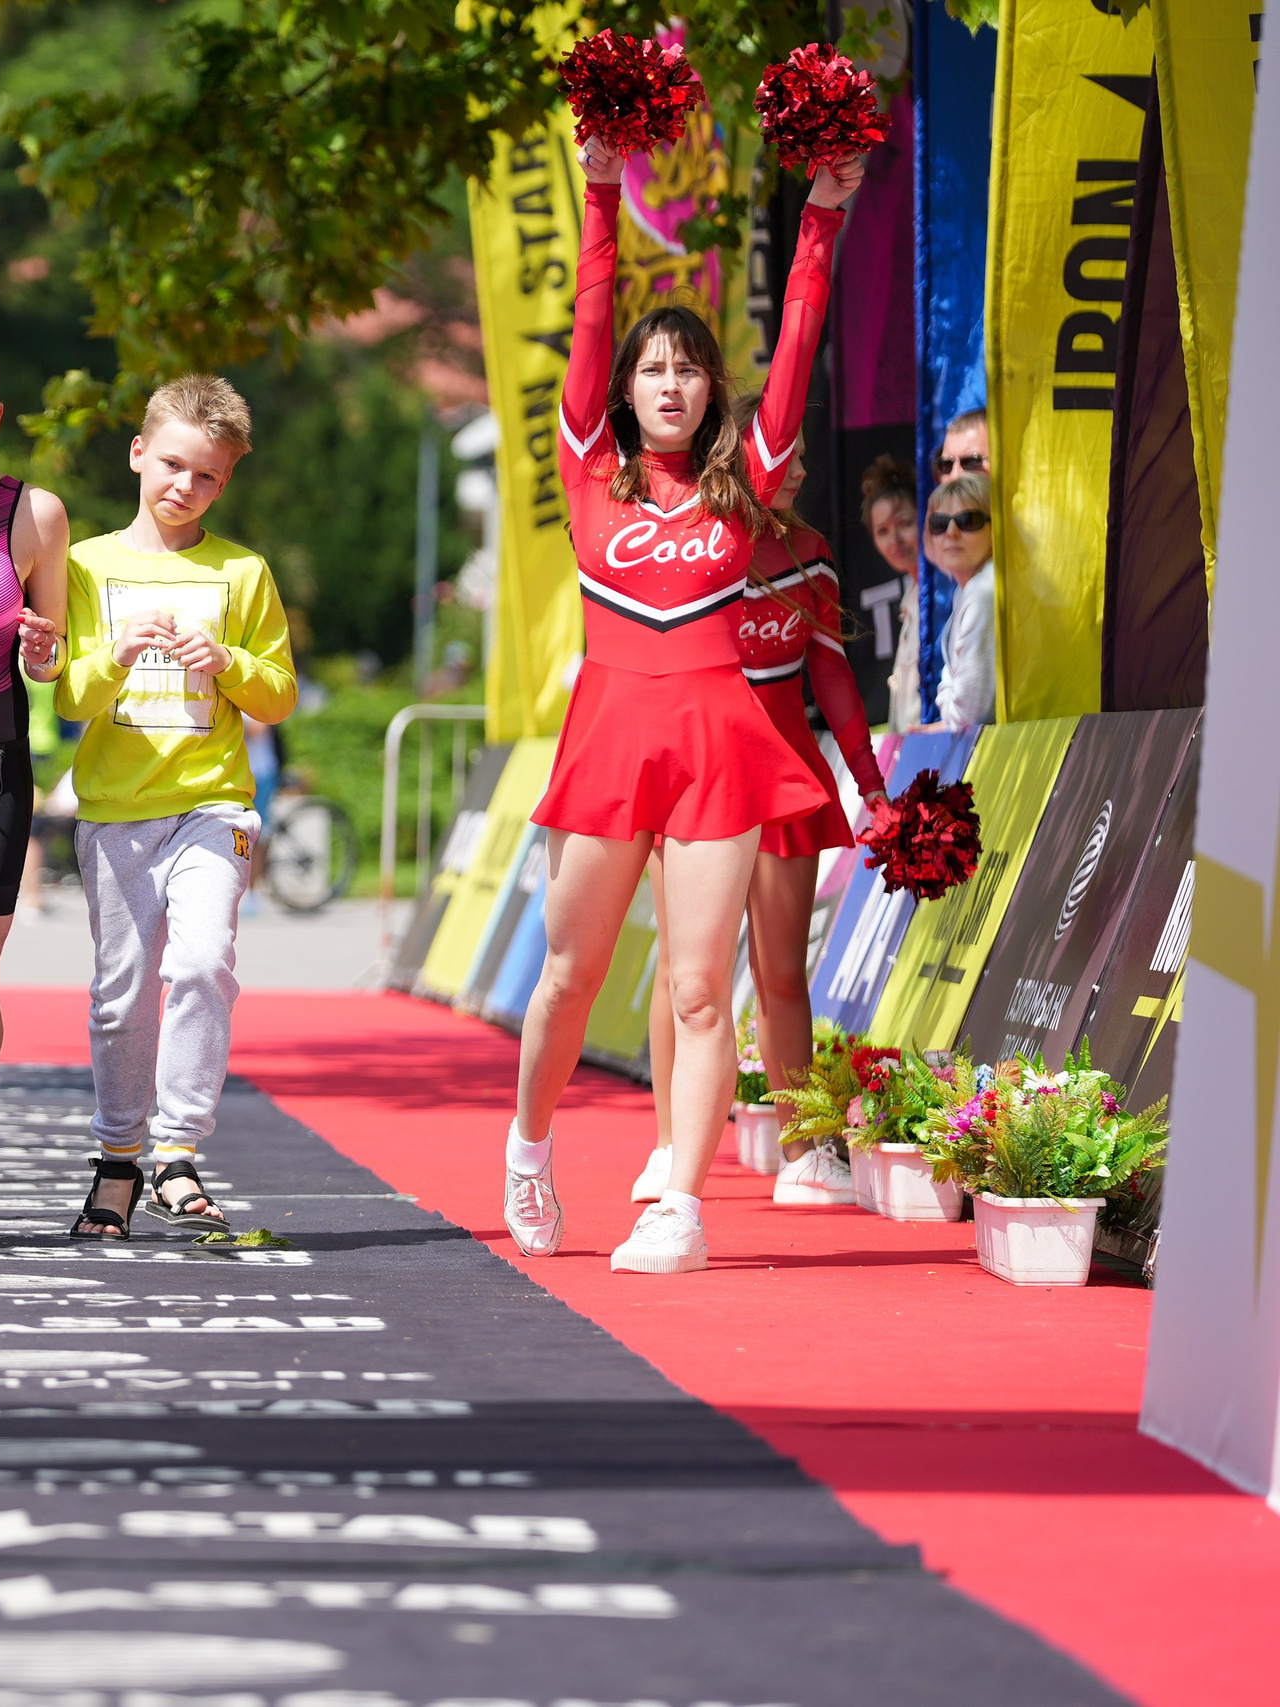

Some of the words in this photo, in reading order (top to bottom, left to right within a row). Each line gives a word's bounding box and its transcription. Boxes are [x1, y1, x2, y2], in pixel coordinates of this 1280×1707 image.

[511, 135, 568, 295] STAR
[606, 519, 726, 569] Cool
[738, 609, 802, 642] ool
[232, 828, 250, 861] R
[957, 850, 1010, 945] STAR
[9, 1246, 314, 1264] STAR
[39, 1315, 388, 1329] STAR
[76, 1399, 473, 1415] STAR
[118, 1509, 599, 1551] STAR
[146, 1580, 679, 1616] STAR
